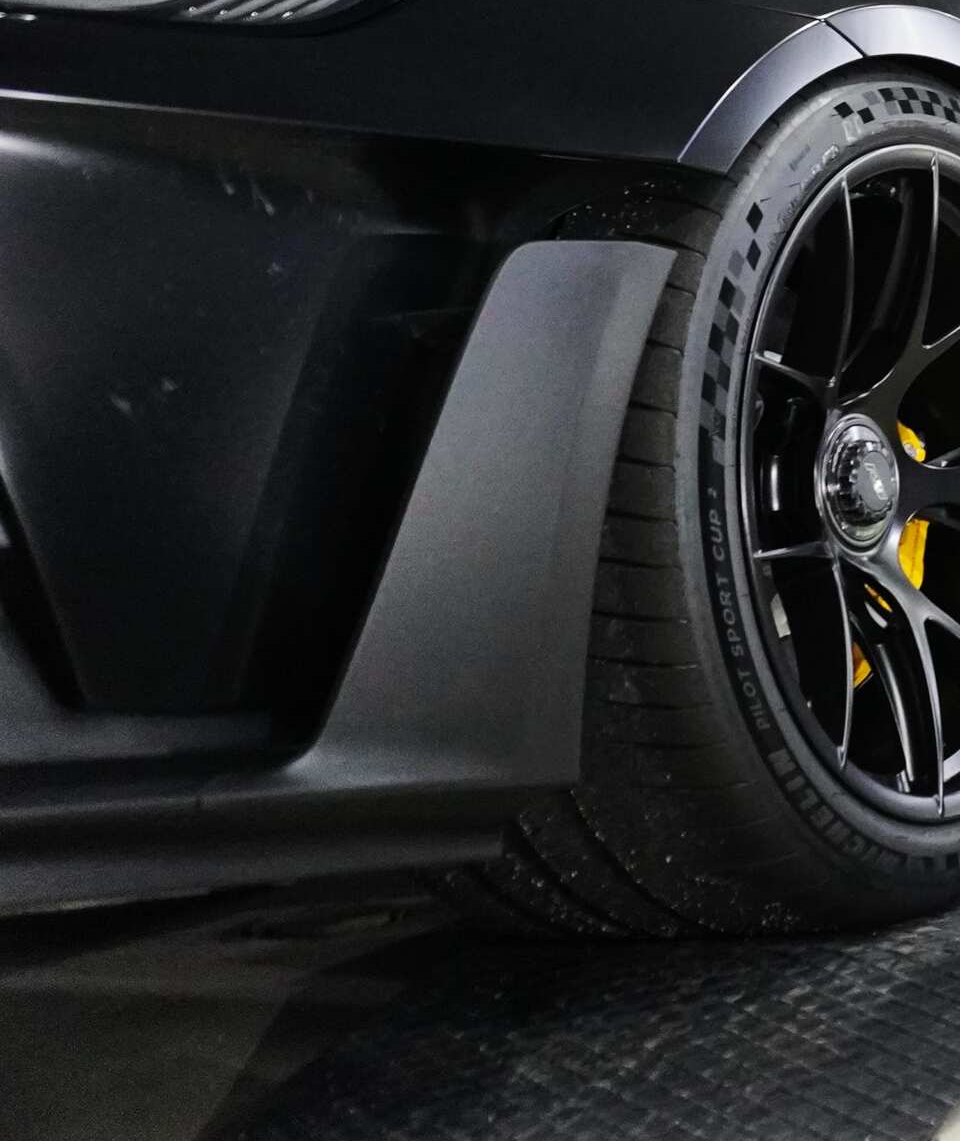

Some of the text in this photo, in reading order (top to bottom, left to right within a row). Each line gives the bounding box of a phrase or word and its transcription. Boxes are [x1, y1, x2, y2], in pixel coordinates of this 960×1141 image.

[708, 508, 725, 561] CUP
[715, 571, 745, 657] SPORT
[737, 666, 771, 731] PILOT
